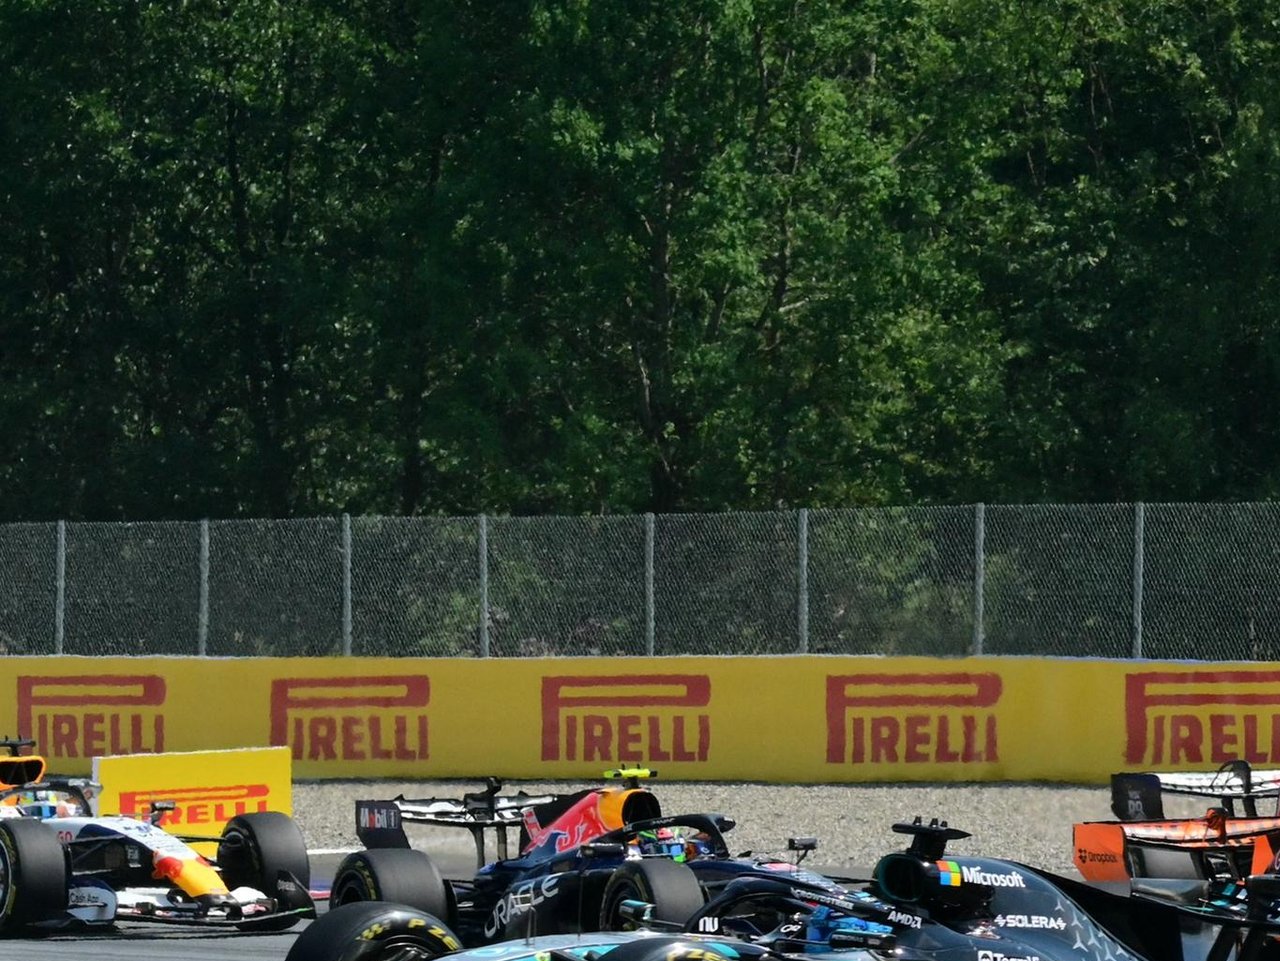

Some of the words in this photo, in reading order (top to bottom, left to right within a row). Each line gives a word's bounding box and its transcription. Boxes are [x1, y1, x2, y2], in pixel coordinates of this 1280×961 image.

[17, 675, 167, 758] PIRELLI
[271, 675, 430, 761] PIRELLI
[541, 674, 711, 762] PIRELLI
[826, 672, 1003, 765] PIRELLI
[360, 807, 388, 830] Mobil
[484, 874, 560, 939] ORACLE
[962, 865, 1026, 888] Microsoft
[888, 910, 913, 927] AMD
[1006, 914, 1057, 930] SOLERA
